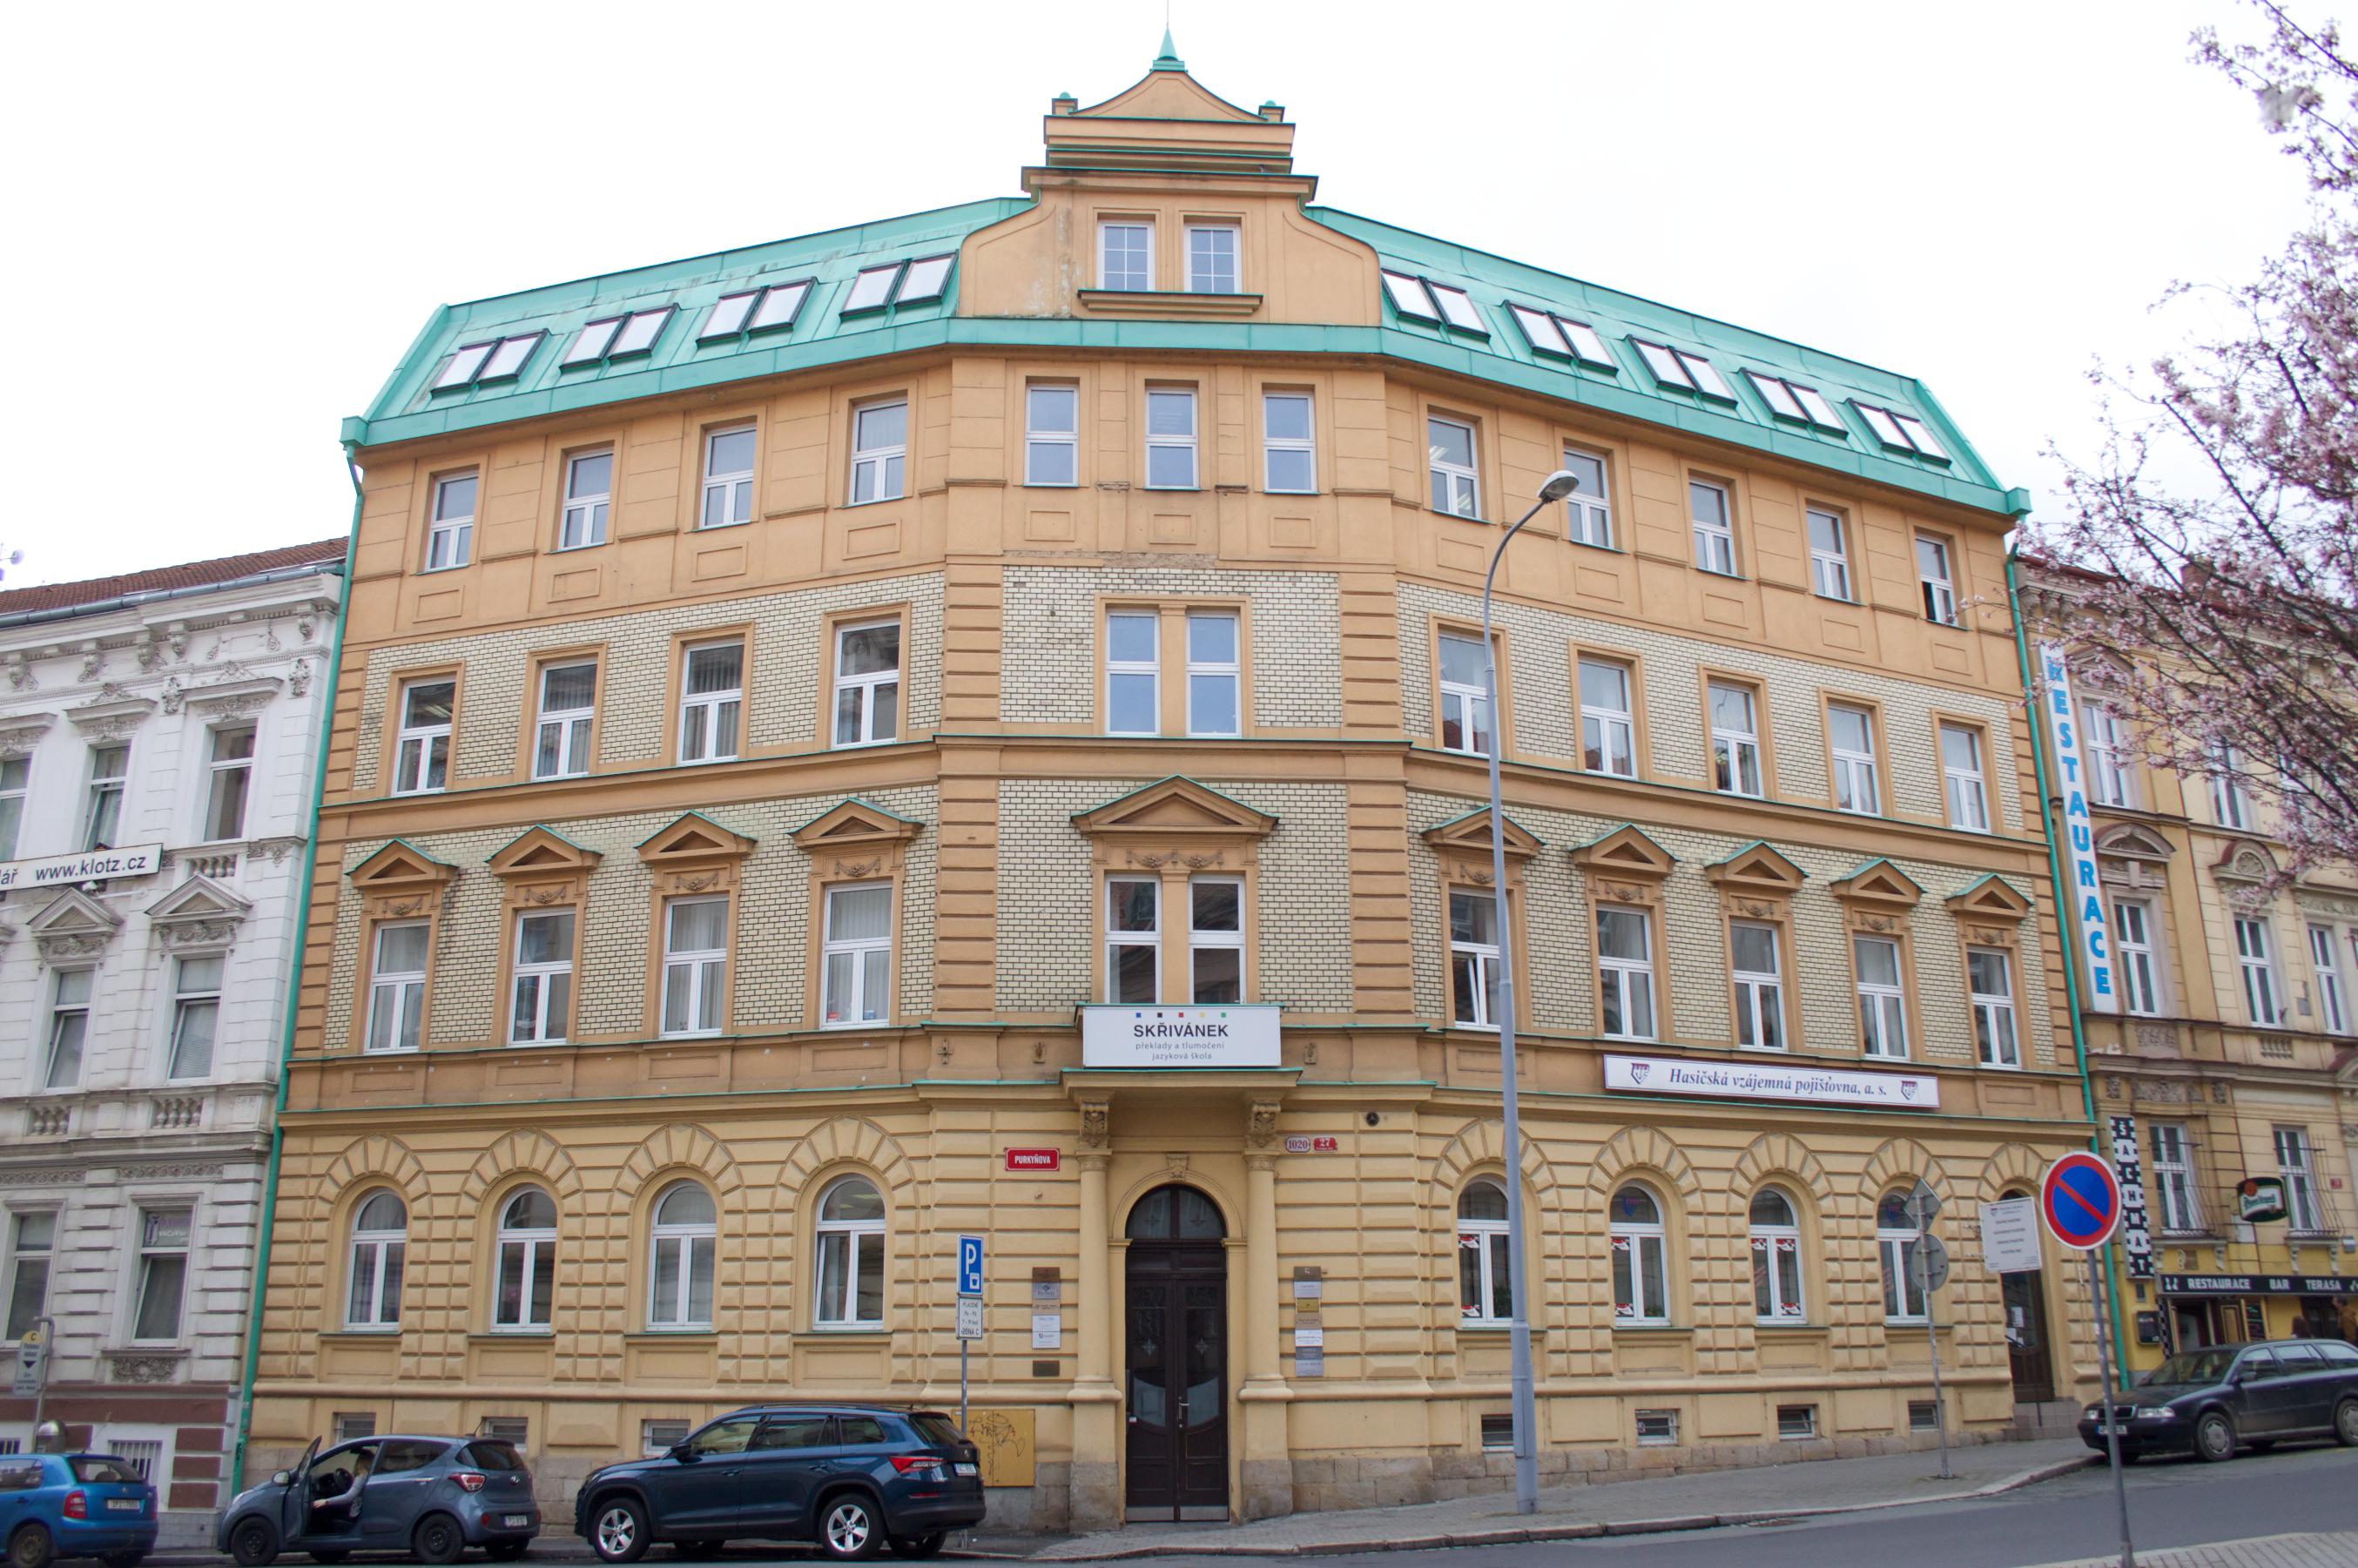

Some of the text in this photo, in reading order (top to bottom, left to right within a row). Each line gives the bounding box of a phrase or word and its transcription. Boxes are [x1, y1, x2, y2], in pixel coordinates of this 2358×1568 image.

[36, 856, 147, 881] www.klotz.cz
[1134, 1022, 1229, 1038] SKŘIVÁNEK
[1135, 1041, 1172, 1051] překlady
[1182, 1041, 1224, 1050] tlumočení
[1669, 1068, 1887, 1096] Hasičská vzájemná pojišťovna, a. s.
[1289, 1140, 1308, 1149] 1020
[1014, 1154, 1051, 1164] PURKYŇOVA
[2119, 1121, 2146, 1271] ŠACHMAT
[966, 1243, 977, 1275] P
[2187, 1278, 2341, 1290] RESTAURACE BAR TERASA
